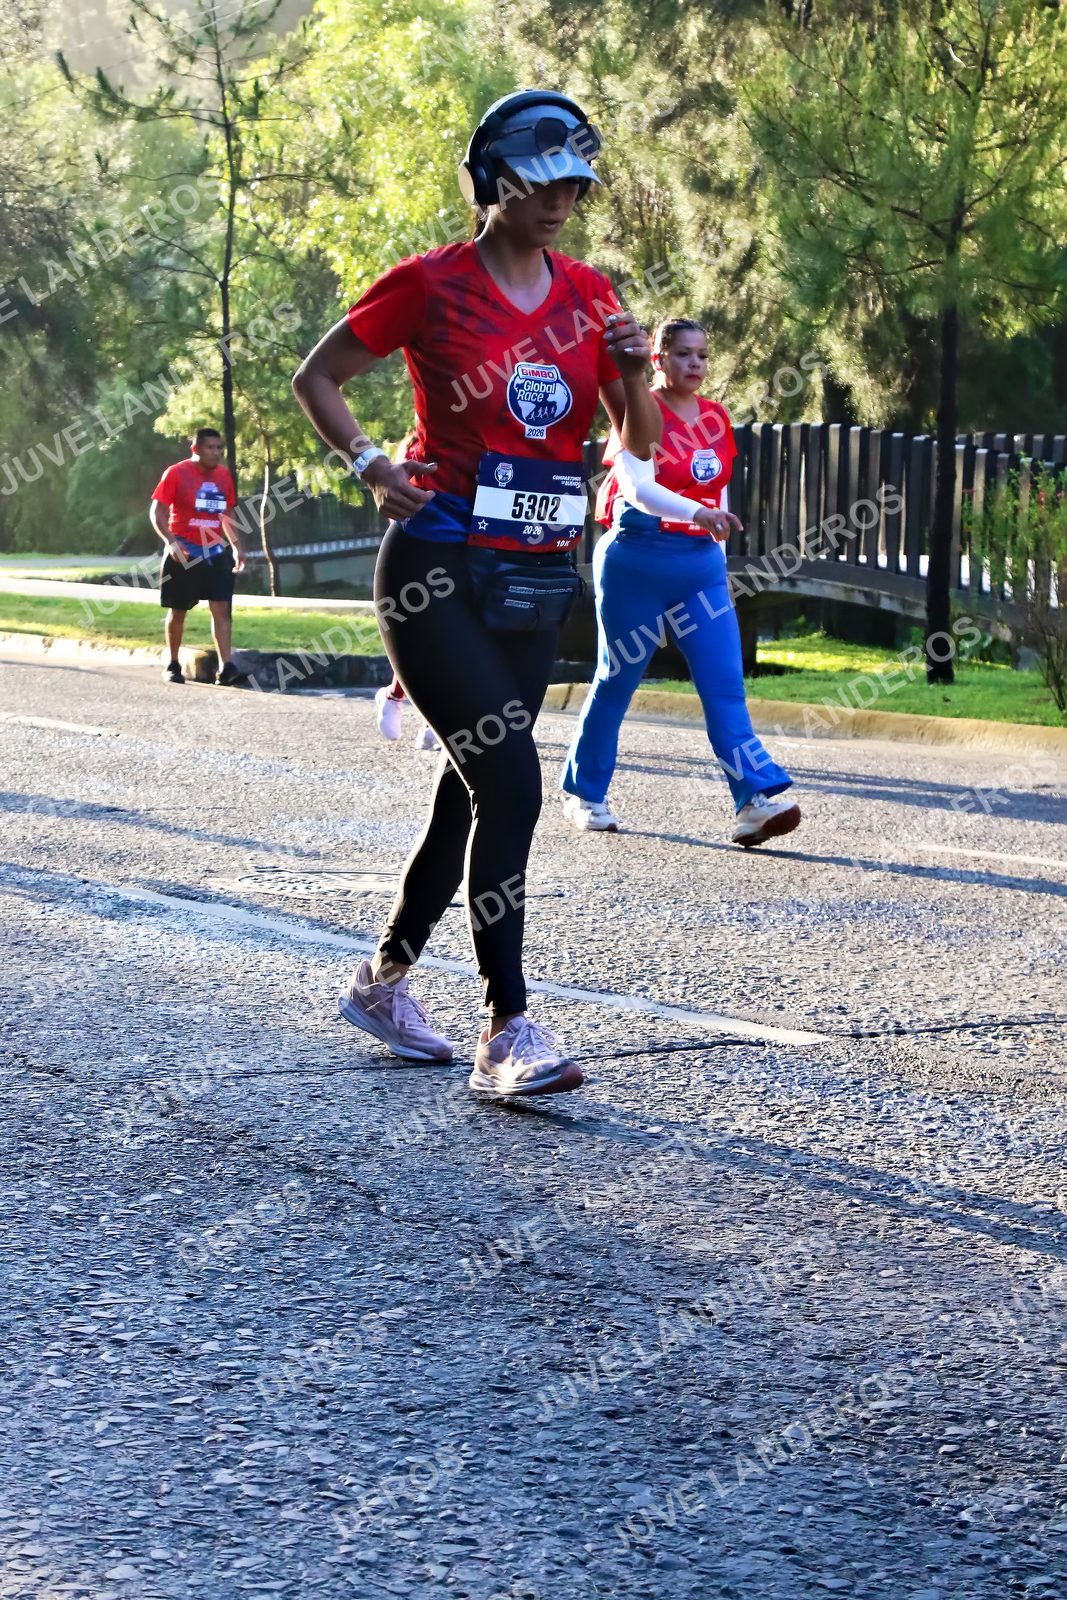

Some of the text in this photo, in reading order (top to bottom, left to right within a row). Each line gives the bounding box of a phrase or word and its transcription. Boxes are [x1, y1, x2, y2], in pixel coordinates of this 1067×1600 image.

[523, 380, 556, 394] Global
[516, 389, 544, 402] Race
[527, 428, 545, 438] 2026
[511, 493, 561, 522] 5302
[556, 540, 571, 548] 10K
